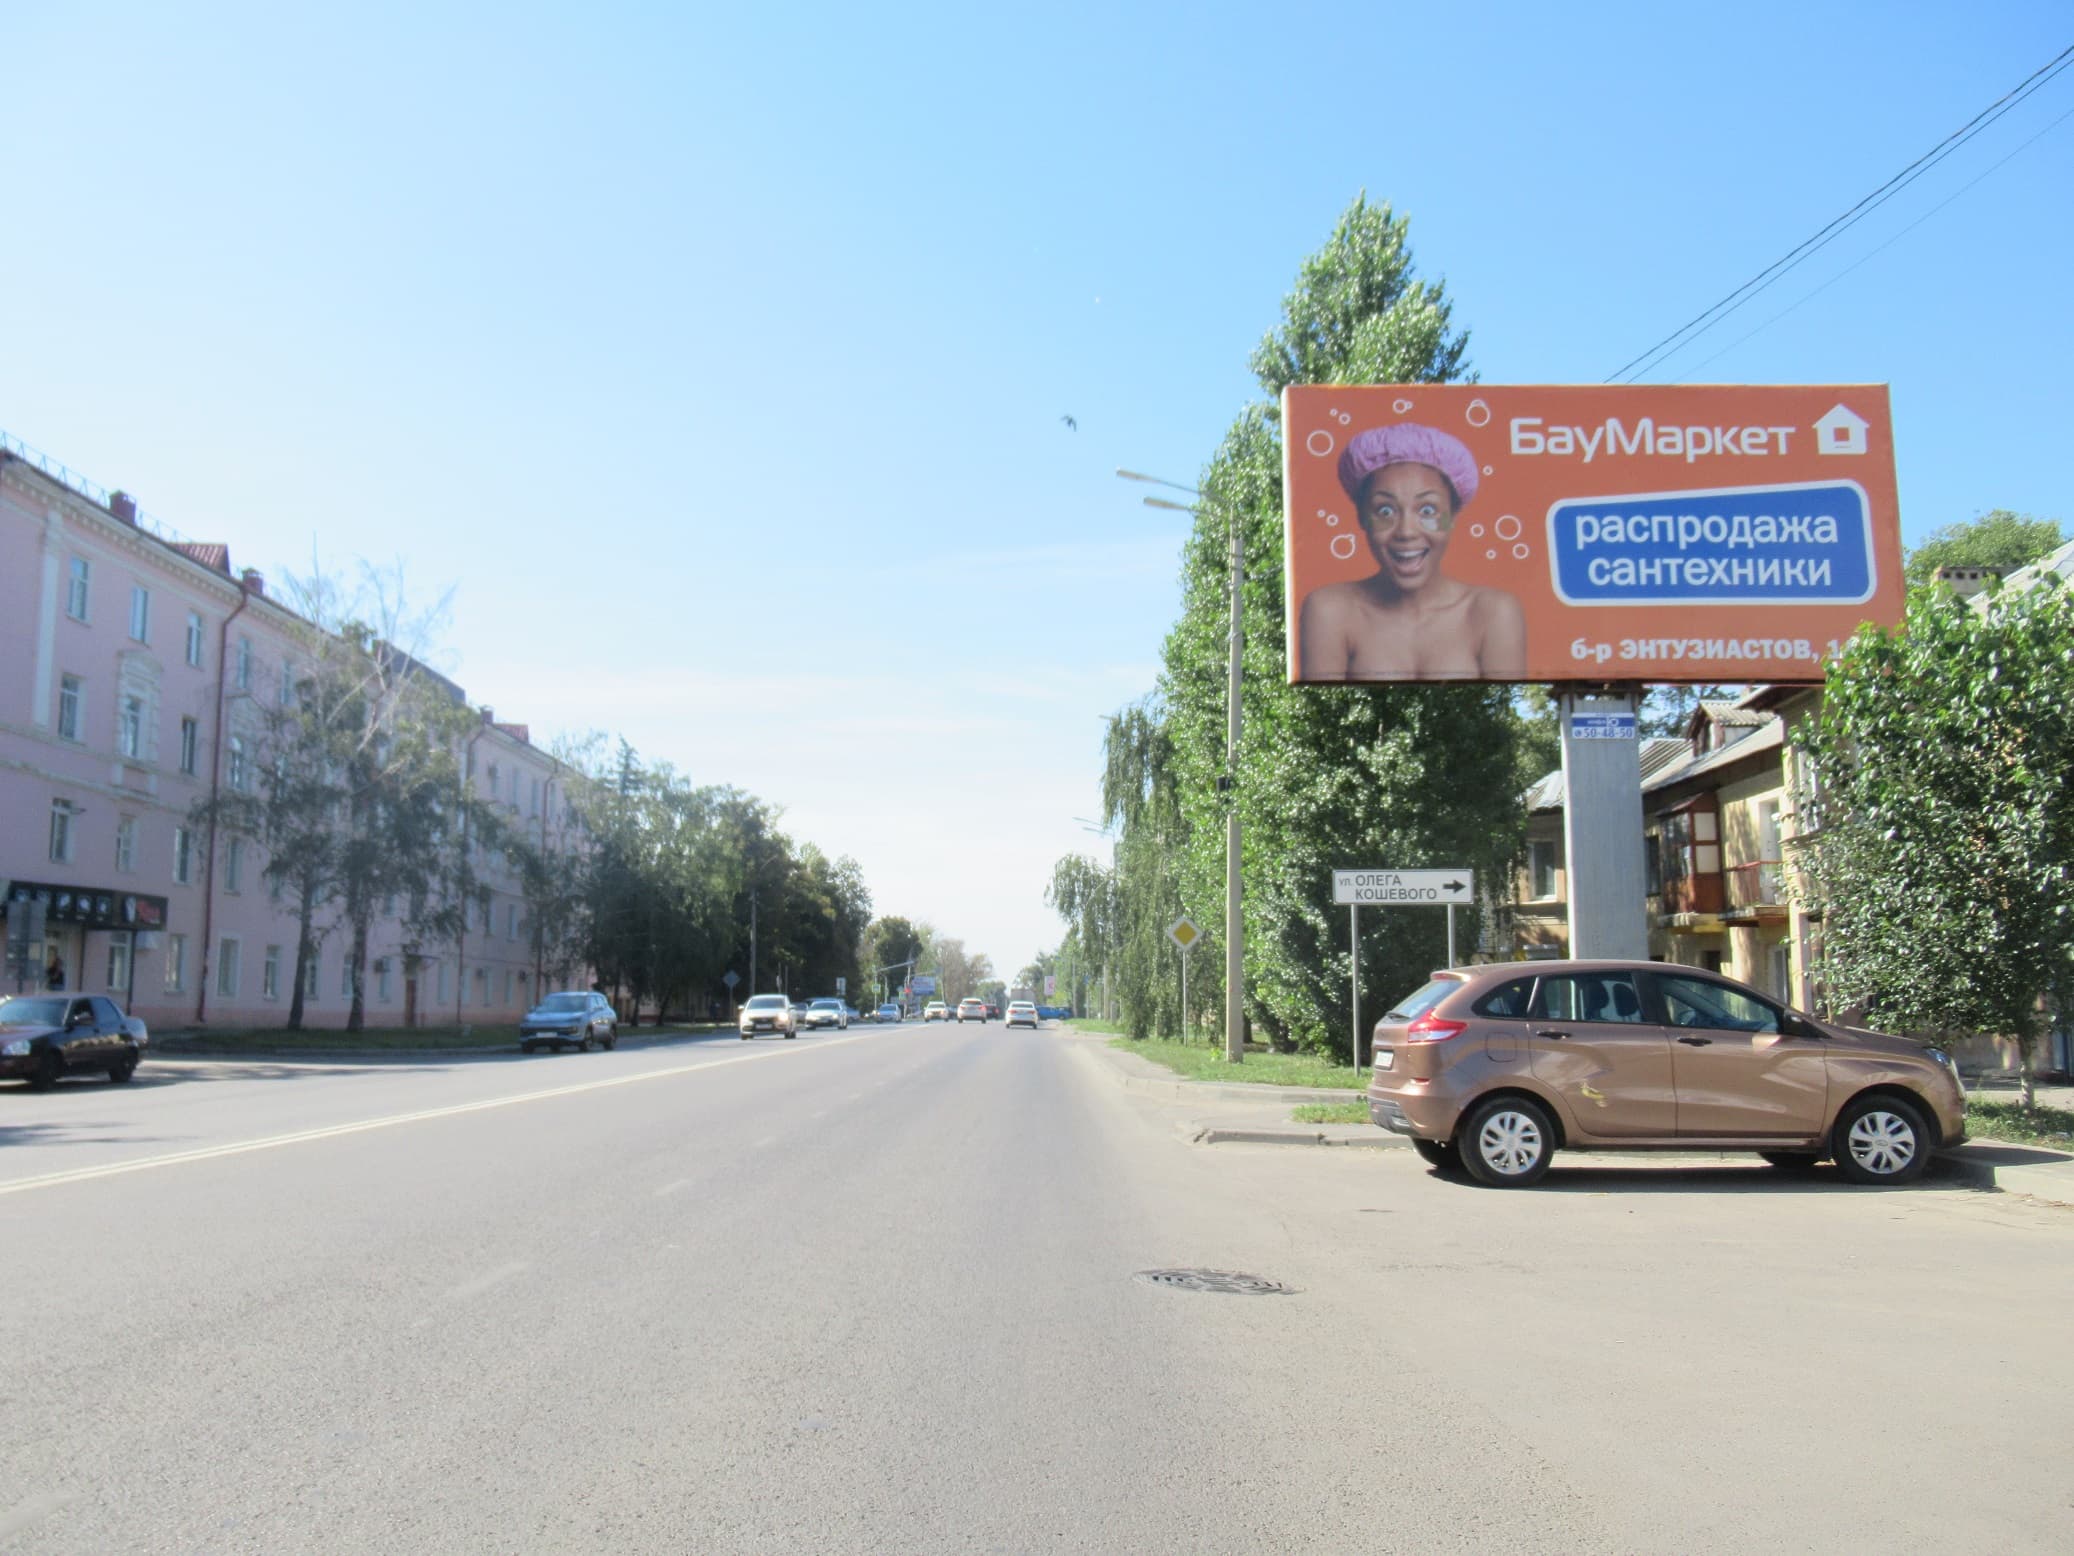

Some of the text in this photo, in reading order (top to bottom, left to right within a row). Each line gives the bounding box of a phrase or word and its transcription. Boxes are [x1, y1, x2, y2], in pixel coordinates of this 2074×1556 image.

[1510, 417, 1795, 463] БауМаркет
[1576, 513, 1838, 550] распродажа
[1589, 556, 1832, 586] сантехники
[1570, 638, 1612, 663] б-р
[1619, 639, 1819, 663] ЭНТУЗИАСТОВ,
[1338, 874, 1402, 887] ул. ОЛЕГА
[1355, 888, 1438, 900] КОШЕВОГО
